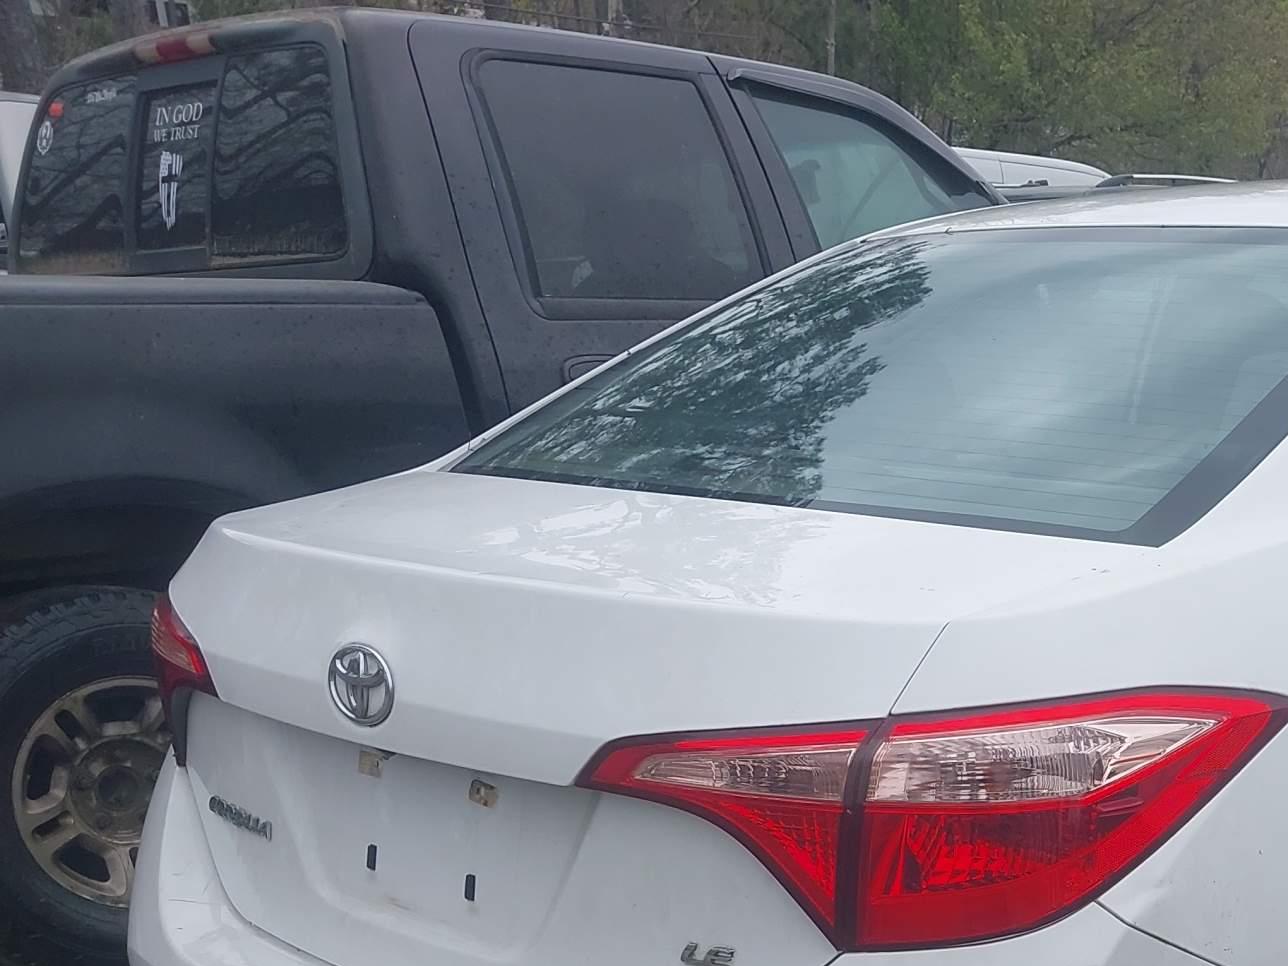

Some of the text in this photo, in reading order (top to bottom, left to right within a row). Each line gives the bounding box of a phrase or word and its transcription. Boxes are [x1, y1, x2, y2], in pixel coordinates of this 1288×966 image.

[156, 102, 203, 126] IN GOD
[153, 124, 201, 142] WE TRUST
